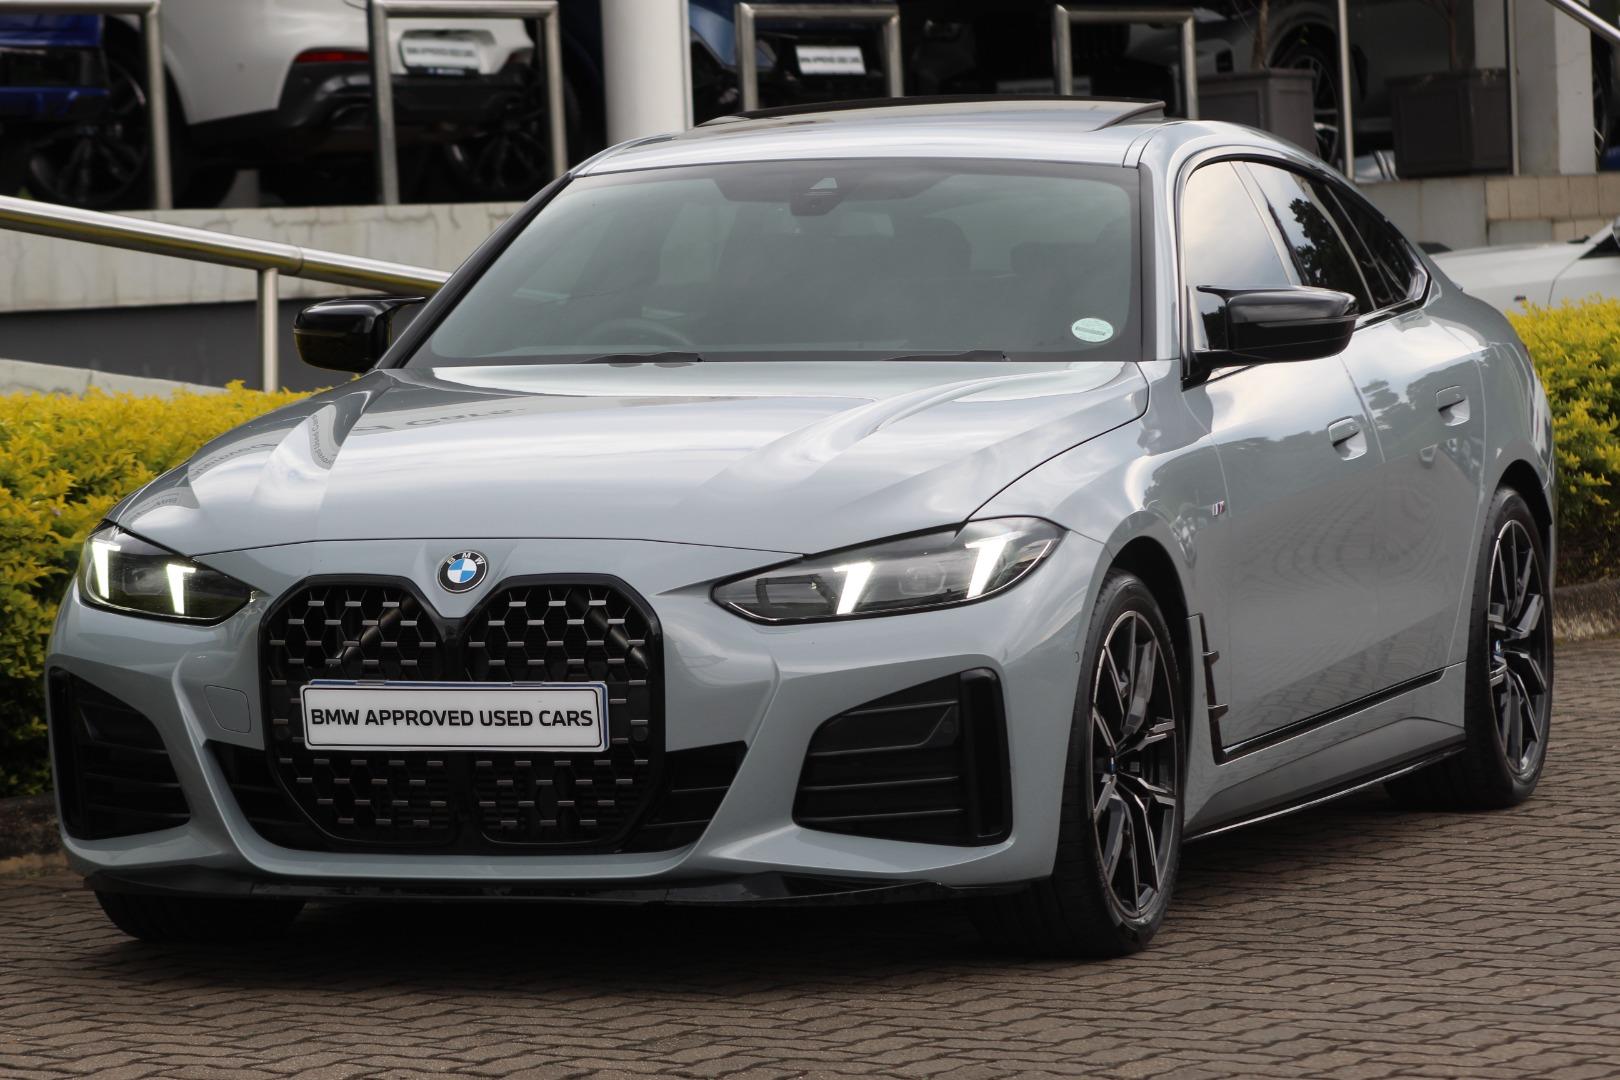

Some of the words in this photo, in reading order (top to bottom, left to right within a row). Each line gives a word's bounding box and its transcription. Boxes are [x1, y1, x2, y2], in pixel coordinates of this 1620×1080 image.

[446, 552, 485, 565] BMW
[310, 708, 360, 726] BMW
[364, 708, 474, 727] APPROVED
[479, 709, 533, 727] USED
[538, 709, 593, 727] CARS
